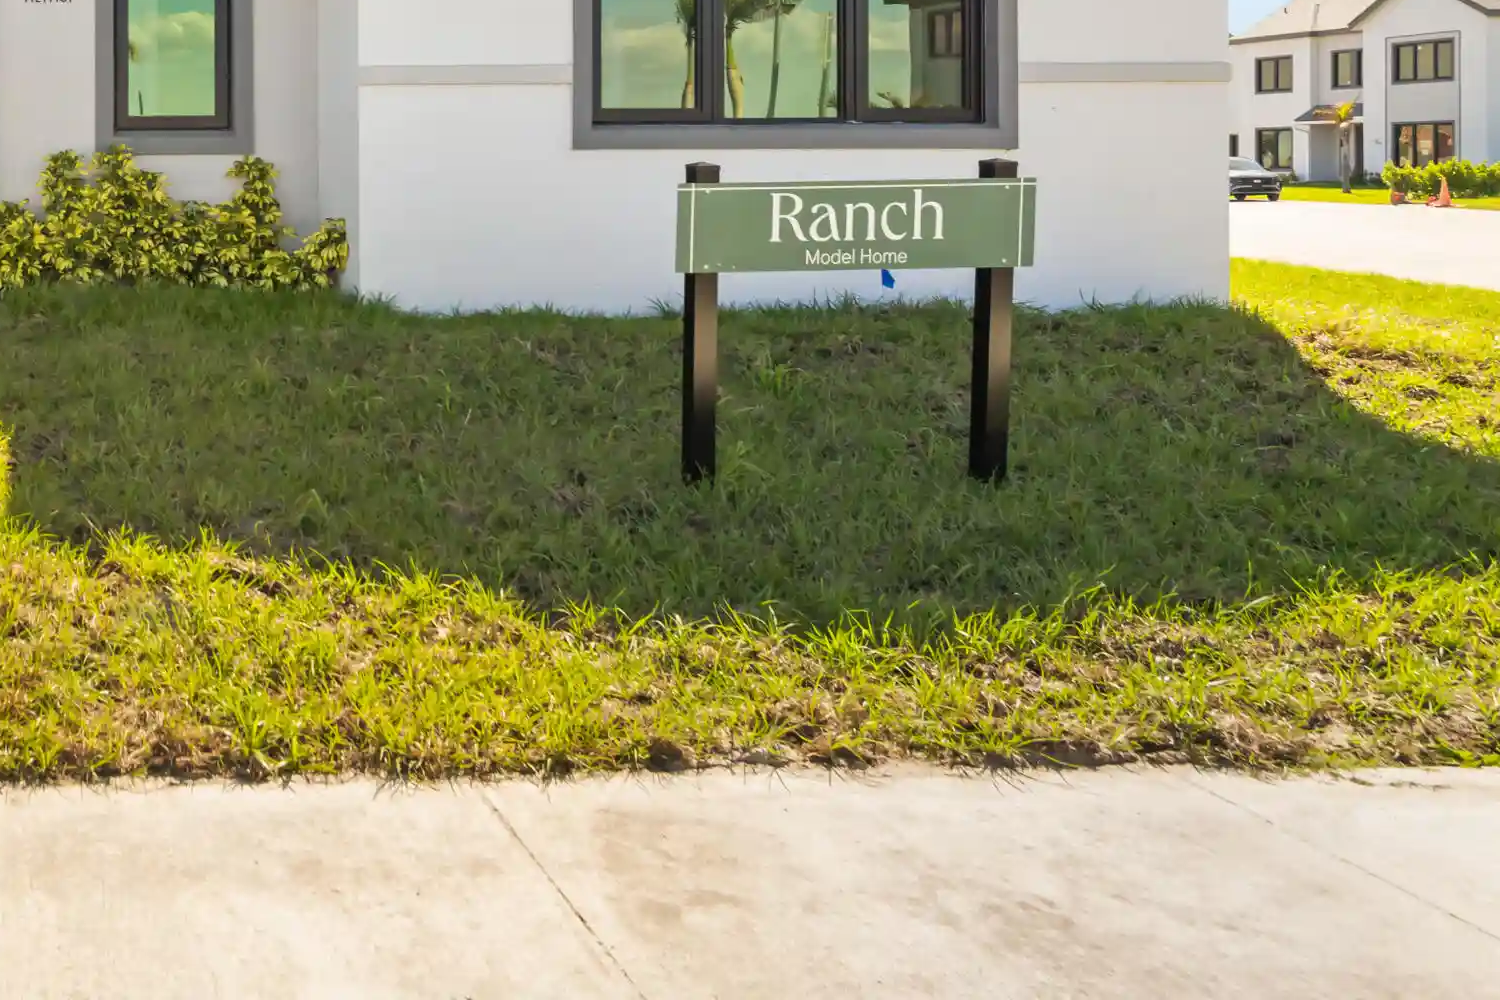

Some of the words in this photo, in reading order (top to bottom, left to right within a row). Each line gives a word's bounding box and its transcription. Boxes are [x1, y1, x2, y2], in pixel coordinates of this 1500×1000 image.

[768, 188, 945, 243] Ranch
[805, 248, 856, 265] Model
[860, 248, 908, 264] Home
